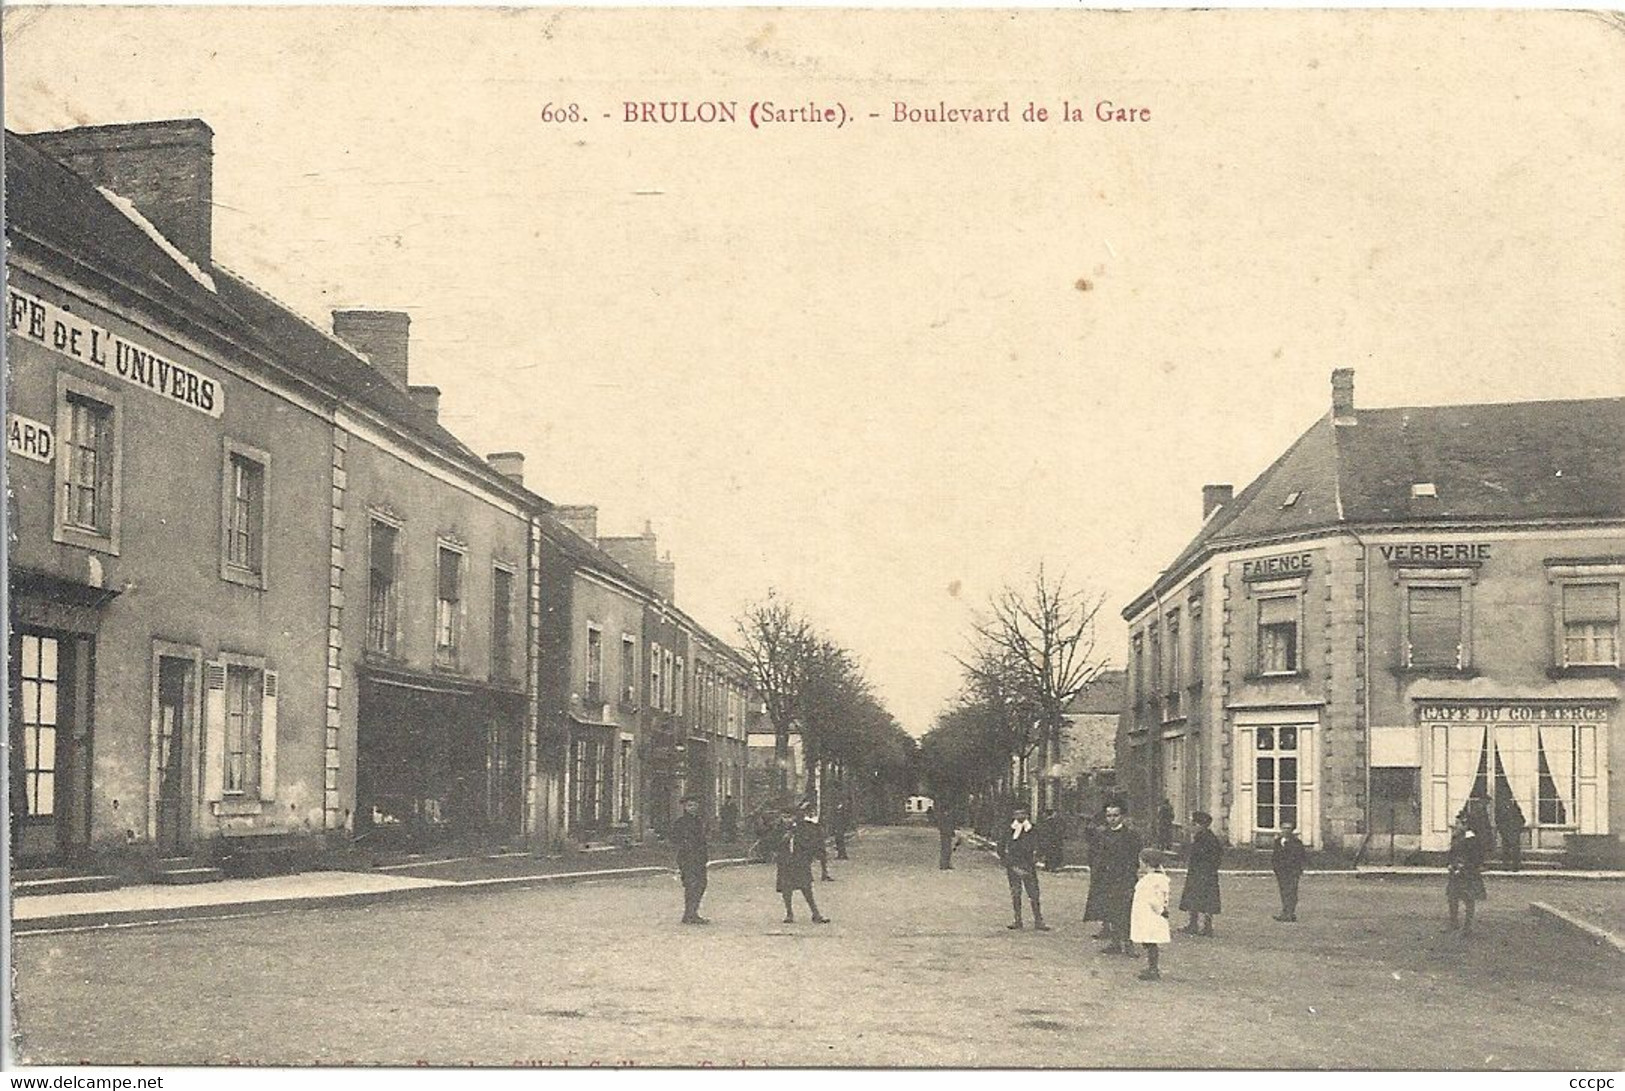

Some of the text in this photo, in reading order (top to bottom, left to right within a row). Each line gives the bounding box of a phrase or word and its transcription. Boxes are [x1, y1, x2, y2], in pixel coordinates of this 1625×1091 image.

[53, 320, 82, 357] DE
[1380, 544, 1491, 561] VERRERIE
[1478, 706, 1504, 721] DU
[1508, 706, 1608, 721] COMMERCE
